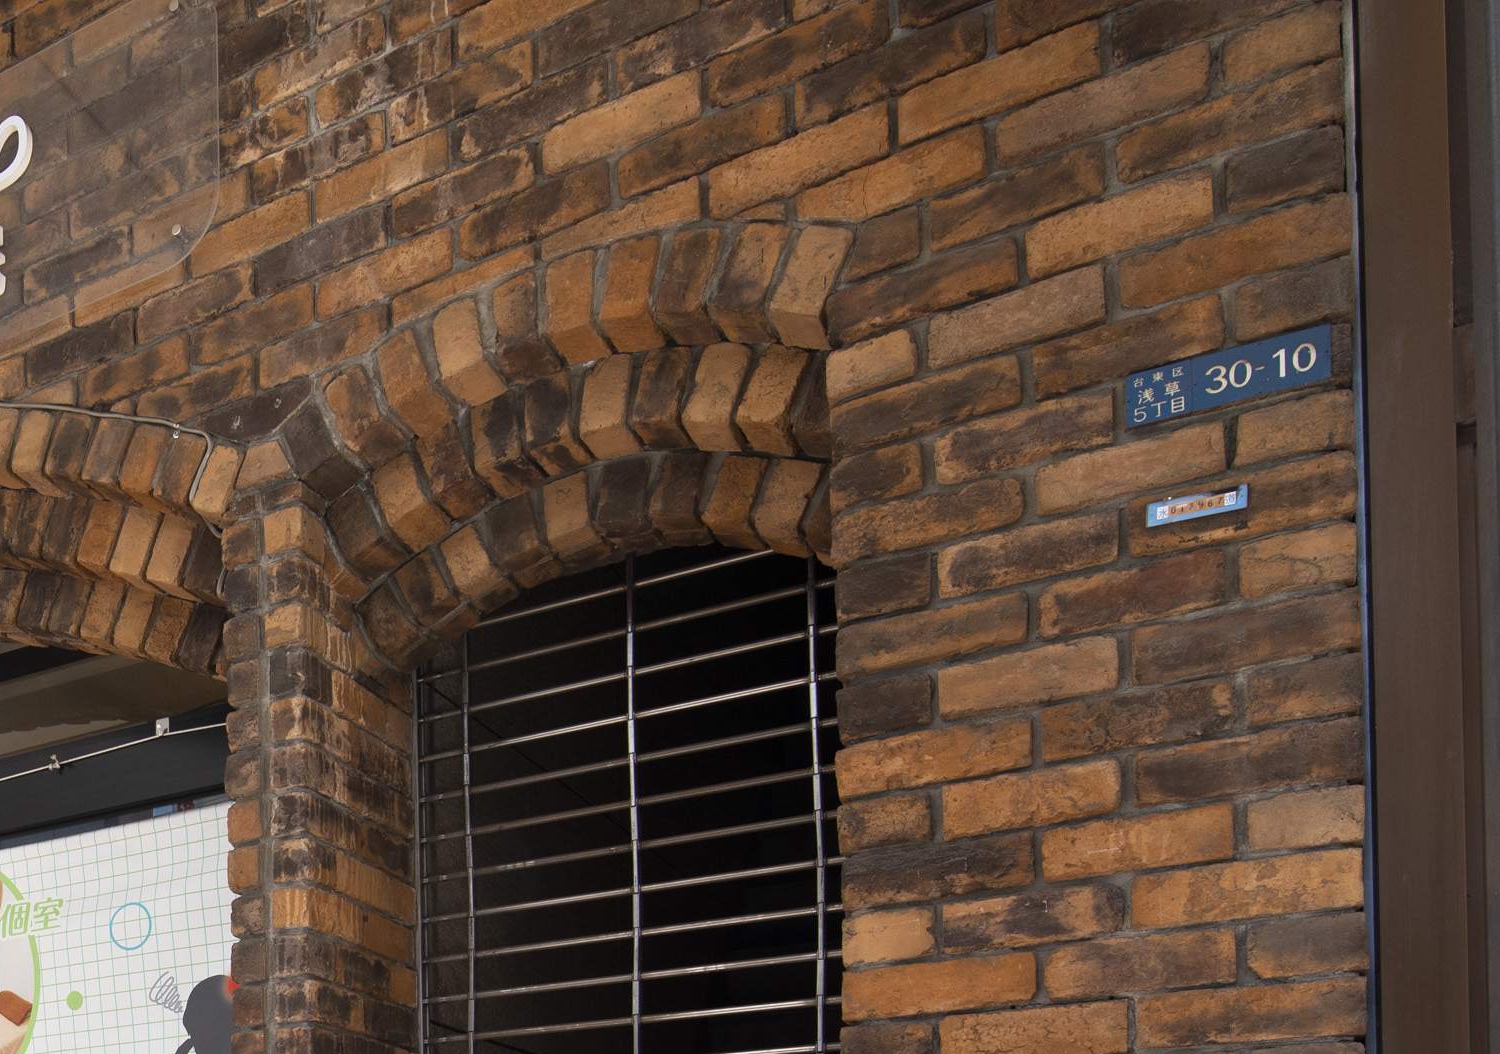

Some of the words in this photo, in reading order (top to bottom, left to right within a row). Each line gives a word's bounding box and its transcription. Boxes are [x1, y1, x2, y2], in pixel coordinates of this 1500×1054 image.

[1133, 366, 1184, 388] 台東区
[1205, 342, 1317, 394] 30-10
[1137, 380, 1181, 405] 浅草
[1133, 396, 1185, 423] 5丁目
[0, 896, 65, 939] 個室
